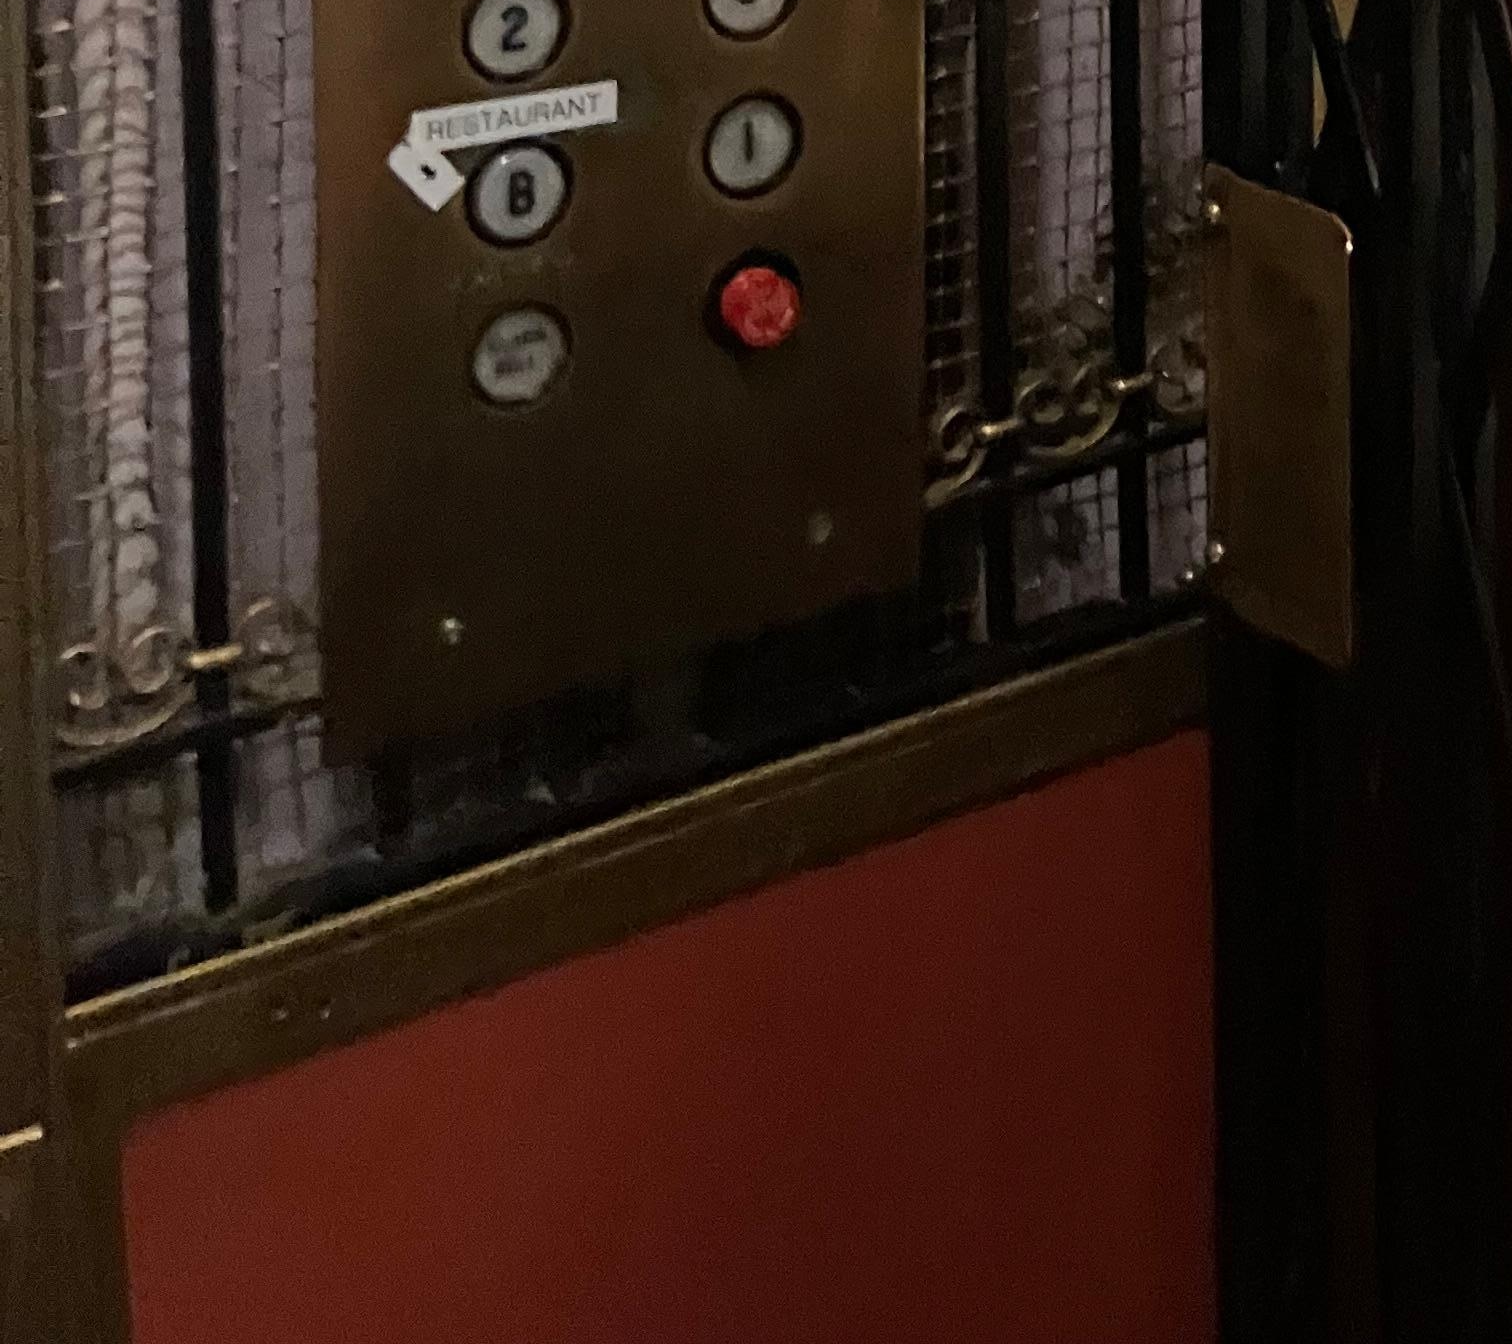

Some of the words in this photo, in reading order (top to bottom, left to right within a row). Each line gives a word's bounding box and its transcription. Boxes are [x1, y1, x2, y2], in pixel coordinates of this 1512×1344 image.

[501, 5, 527, 52] 2
[425, 92, 600, 141] RESTAURANT
[509, 170, 535, 216] B
